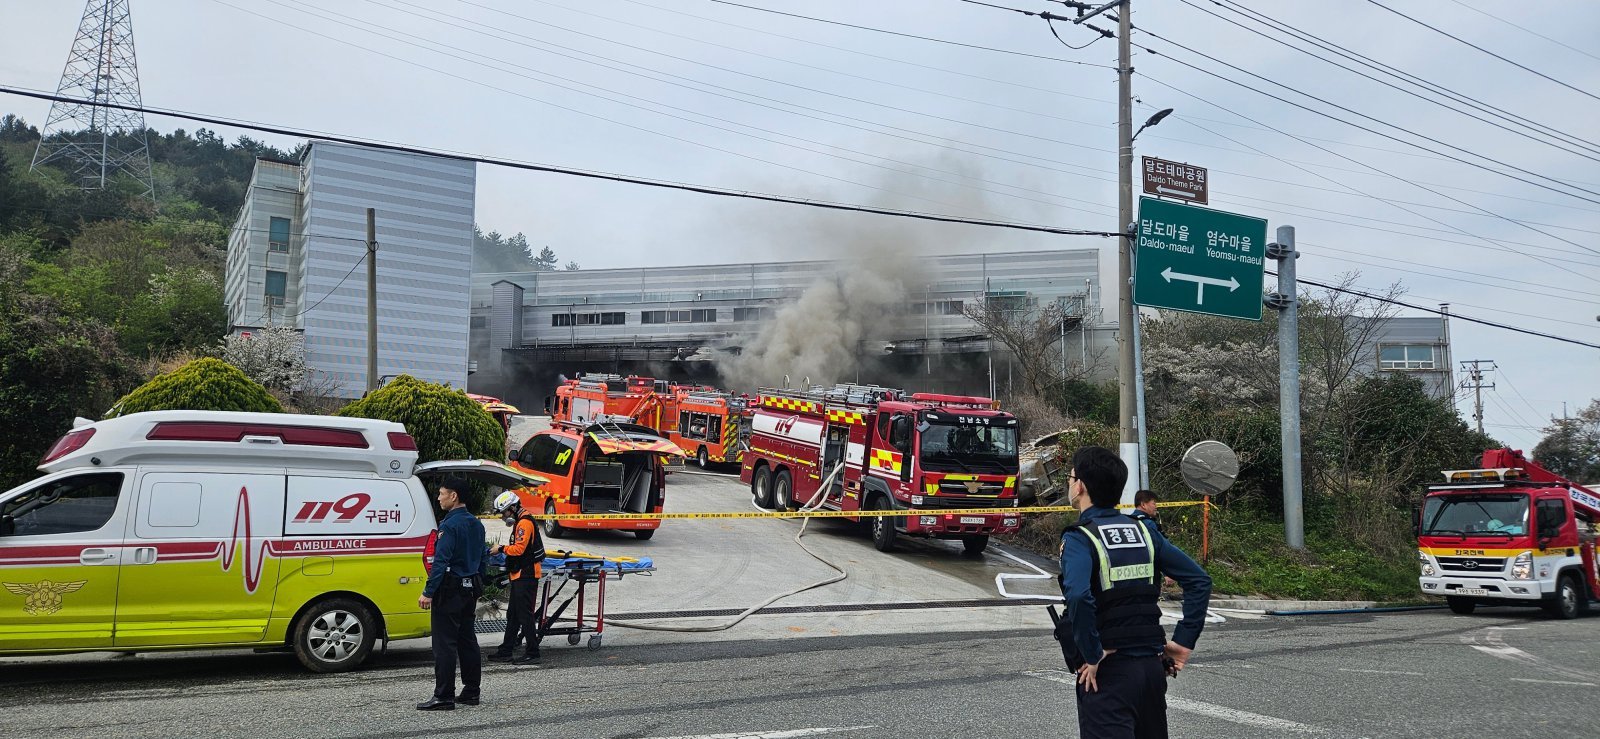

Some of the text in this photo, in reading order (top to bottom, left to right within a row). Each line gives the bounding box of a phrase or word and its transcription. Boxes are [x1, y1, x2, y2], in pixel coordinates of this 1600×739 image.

[1145, 160, 1205, 183] 달도테마공원
[1147, 173, 1204, 191] Daldo Theme Park
[1141, 219, 1190, 242] 달도마을
[1206, 230, 1252, 252] 염수마을
[774, 414, 800, 435] 119
[291, 493, 401, 523] 119 구급대
[293, 539, 367, 551] AMBULANCE
[1107, 527, 1137, 544] 경찰
[1116, 564, 1149, 577] POLICE
